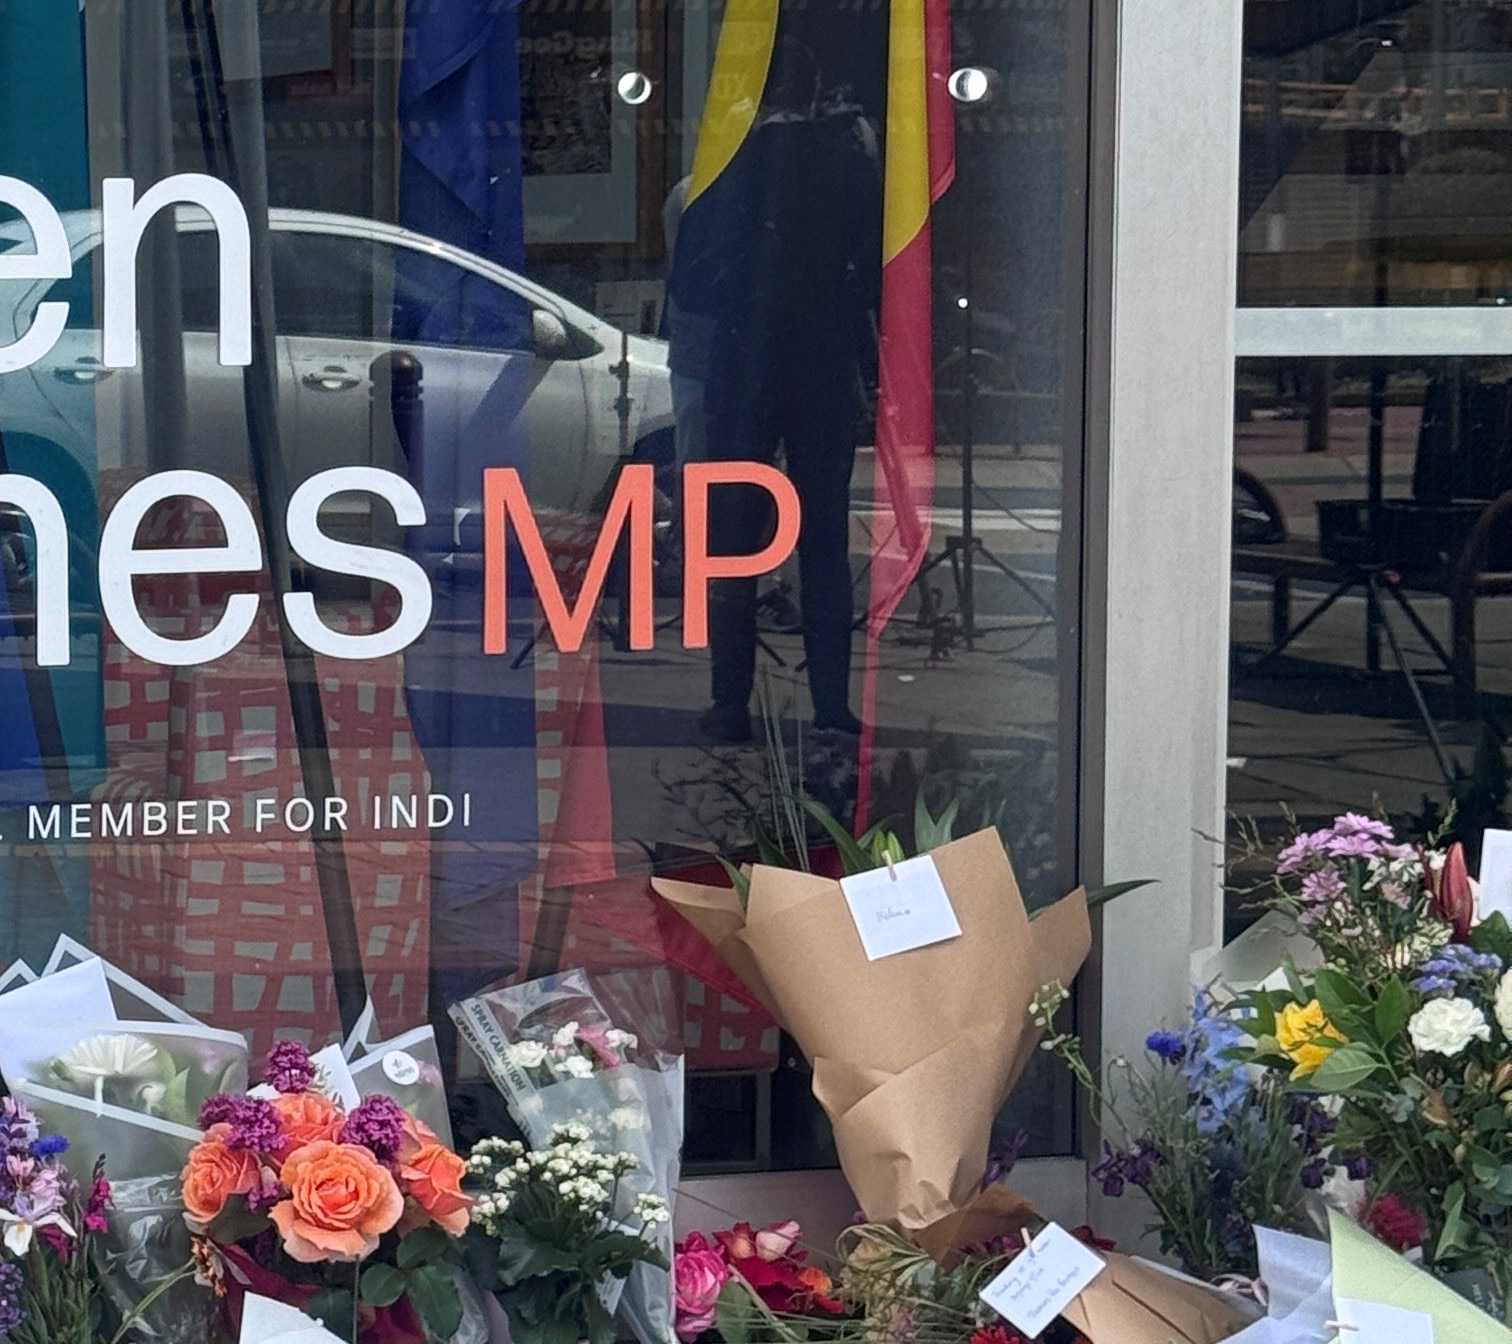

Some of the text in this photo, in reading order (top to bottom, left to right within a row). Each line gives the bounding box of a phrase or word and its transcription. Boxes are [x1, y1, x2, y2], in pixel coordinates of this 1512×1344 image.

[482, 460, 804, 655] MP
[27, 799, 232, 841] MEMBER
[254, 796, 350, 833] FOR
[373, 792, 472, 830] INDI
[470, 1004, 495, 1034] SPRAY
[488, 1034, 527, 1092] CARNATION
